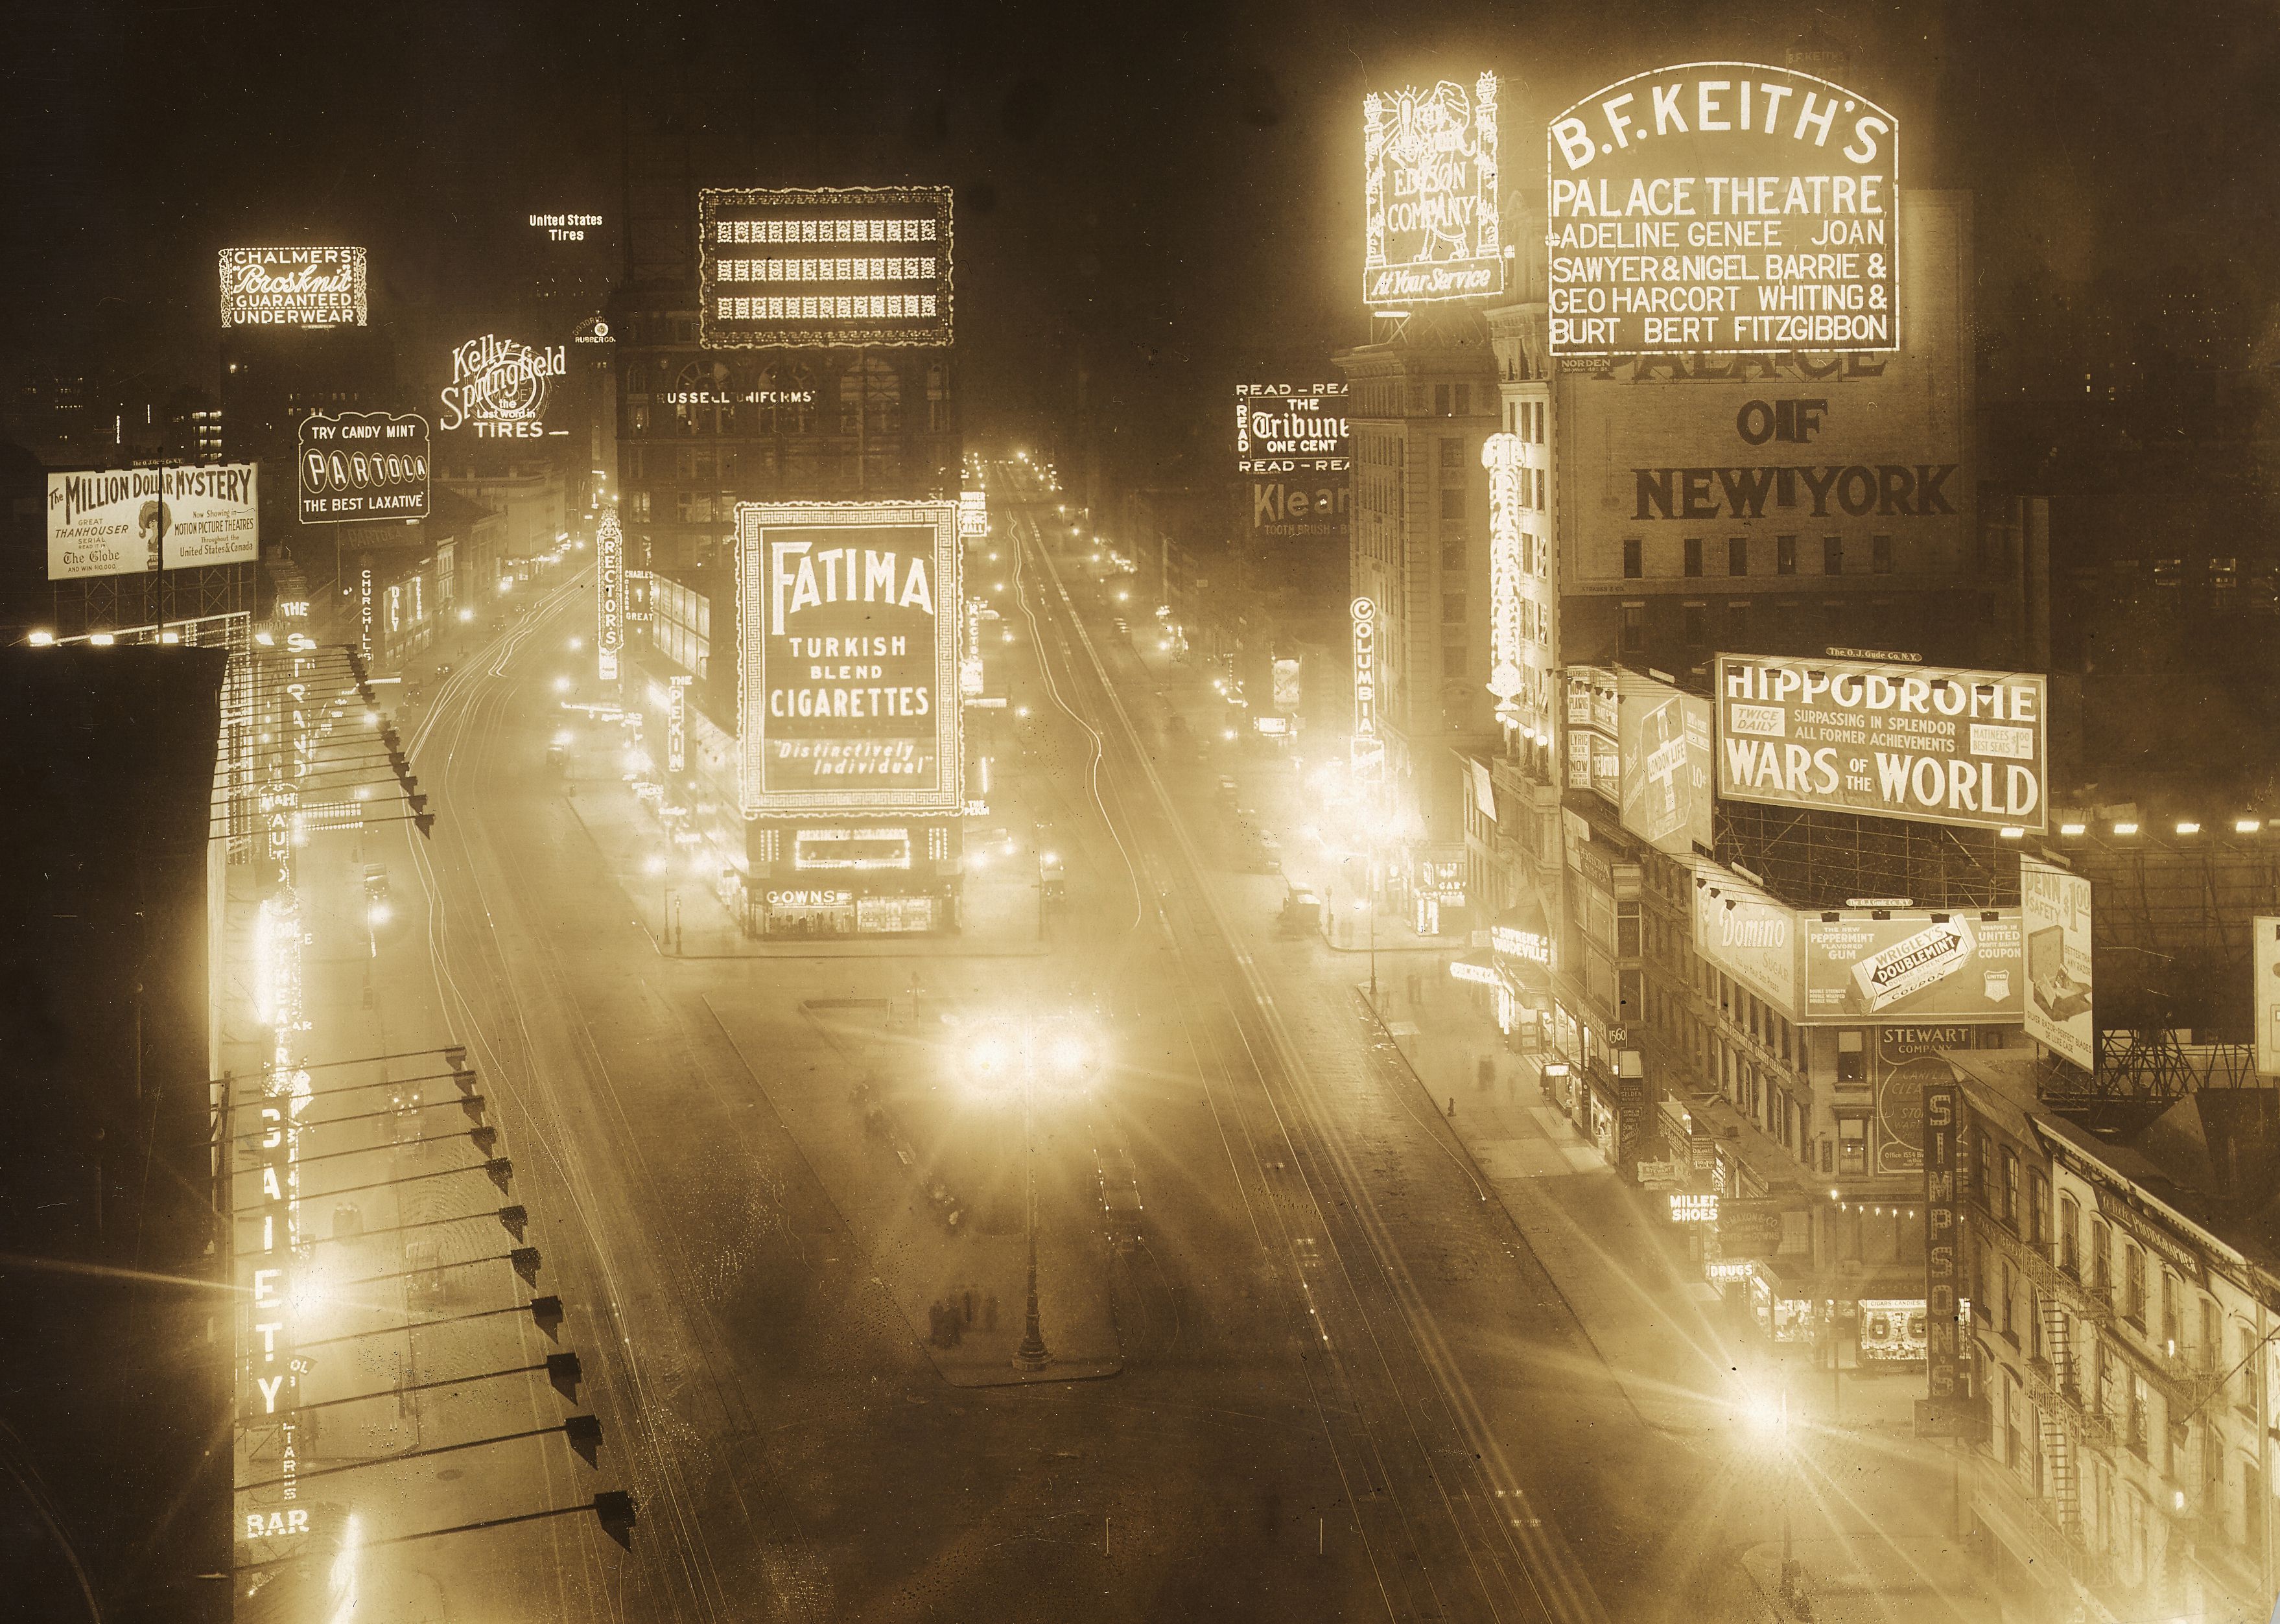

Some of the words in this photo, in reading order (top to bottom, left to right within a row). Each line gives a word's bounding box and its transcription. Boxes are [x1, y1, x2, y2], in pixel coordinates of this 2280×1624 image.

[1394, 161, 1466, 196] EDISON
[1553, 178, 1696, 217] PALACE
[1706, 175, 1884, 215] THEATRE
[530, 215, 565, 226] United
[567, 214, 603, 226] States
[1388, 195, 1477, 231] COMPANY
[548, 229, 584, 241] Tires
[1560, 221, 1679, 249] ADELINE
[1688, 220, 1782, 247] GENEE
[1811, 219, 1885, 246] JOAN
[234, 250, 351, 264] CHALMERS
[1766, 253, 1860, 280] BARRIE
[1867, 253, 1886, 279] &
[1393, 267, 1430, 295] Your
[1427, 264, 1492, 292] Service
[236, 293, 352, 307] GUARANTEED
[1551, 288, 1606, 314] GEO
[1612, 285, 1741, 312] HARCORT
[1758, 283, 1864, 311] WHITING
[1868, 284, 1888, 309] &
[233, 309, 353, 324] UNDERWEAR
[1551, 317, 1621, 344] BURT
[1645, 316, 1719, 343] BERT
[1735, 314, 1888, 342] FITZGIBBON
[1561, 359, 1611, 368] NORDEN
[440, 346, 567, 431] Springfield
[1236, 384, 1291, 395] READ
[499, 399, 517, 409] the
[1287, 399, 1319, 410] THE
[477, 409, 497, 419] Last
[500, 409, 526, 419] word
[1737, 397, 1828, 445] OF
[312, 427, 336, 440] TRY
[342, 425, 381, 439] CANDY
[386, 425, 416, 438] MINT
[473, 421, 543, 438] TIRES
[1236, 405, 1249, 452] READ
[1267, 440, 1296, 453] ONE
[1300, 440, 1337, 452] CENT
[308, 454, 425, 486] PARTOLA
[1239, 461, 1295, 472] READ
[49, 488, 64, 510] The
[65, 476, 129, 525] MILLION
[176, 469, 252, 505] MYSTERY
[1630, 467, 1778, 521] NEW
[1794, 464, 1960, 517] YORK
[304, 499, 327, 512] THE
[332, 497, 363, 511] BEST
[369, 495, 423, 509] LAXATIVE
[207, 509, 230, 519] Showing
[56, 524, 129, 539] THANHOUSER
[174, 523, 196, 536] MOTION
[198, 521, 224, 534] PICTURE
[224, 518, 253, 532] THEATRES
[201, 536, 229, 545] Throughout
[64, 551, 85, 564] The
[89, 549, 120, 562] Globe
[180, 545, 202, 558] United
[625, 571, 653, 579] CHARLES
[770, 541, 934, 635] FATIMA
[280, 602, 310, 617] THE
[391, 586, 399, 632] DALY
[626, 611, 653, 622] GREAT
[788, 636, 907, 658] TURKISH
[810, 665, 883, 680] BLEND
[1355, 600, 1374, 733] COLUMBIA
[670, 676, 692, 685] THE
[1726, 665, 2037, 722] HIPPODROME
[770, 687, 930, 718] CIGARETTES
[1738, 707, 1779, 722] TWICE
[1794, 709, 1866, 729] SURPASSING
[1870, 716, 1882, 729] IN
[1888, 717, 1956, 736] SPLENDOR
[670, 689, 682, 769] PEKIN
[1737, 718, 1778, 733] DAILY
[1570, 735, 1588, 746] LYRIC
[1794, 726, 1816, 740] ALL
[1820, 728, 1866, 745] FORMER
[1869, 733, 1956, 753] ACHIEVEMENTS
[1973, 728, 2009, 741] MATINEES
[1973, 740, 1989, 751] BEST
[1990, 741, 2010, 753] SEATS
[1571, 760, 1588, 771] NOW
[1648, 750, 1671, 778] LONDON
[1671, 741, 1686, 763] LIFE
[1724, 738, 1839, 795] WARS
[1849, 758, 1868, 774] OF
[1845, 775, 1872, 792] THE
[1874, 752, 2039, 817] WORLD
[2025, 865, 2061, 905] PENN
[766, 889, 835, 904] GOWNS
[2028, 896, 2061, 924] SAFETY
[1719, 904, 1785, 948] Domino
[1810, 932, 1875, 944] PEPPERMINT
[1978, 931, 2021, 941] UNITED
[1828, 949, 1857, 960] GUM
[1875, 925, 1946, 967] WRIGLEY'S
[1978, 948, 2022, 959] COUPON
[2065, 945, 2081, 959] BETTER
[1763, 952, 1789, 983] SUGAR
[1876, 935, 1957, 983] DOUBLEMINT
[1888, 972, 1916, 987] DOUBLE
[1916, 952, 1955, 974] STRENGTH
[1891, 971, 1946, 1000] COUPON
[1609, 1030, 1626, 1044] 1560
[1884, 1029, 1969, 1043] STEWART
[2027, 1011, 2041, 1025] SILVER
[2075, 1037, 2092, 1054] BLADES
[1898, 1044, 1953, 1053] COMPANY
[2052, 1035, 2062, 1047] LUXE
[2063, 1041, 2073, 1053] CASE
[1672, 1208, 1719, 1221] SHOES
[2131, 1214, 2198, 1275] PHOTOGRAPHER
[1710, 1264, 1754, 1277] DRUGS
[246, 1509, 310, 1538] BAR
